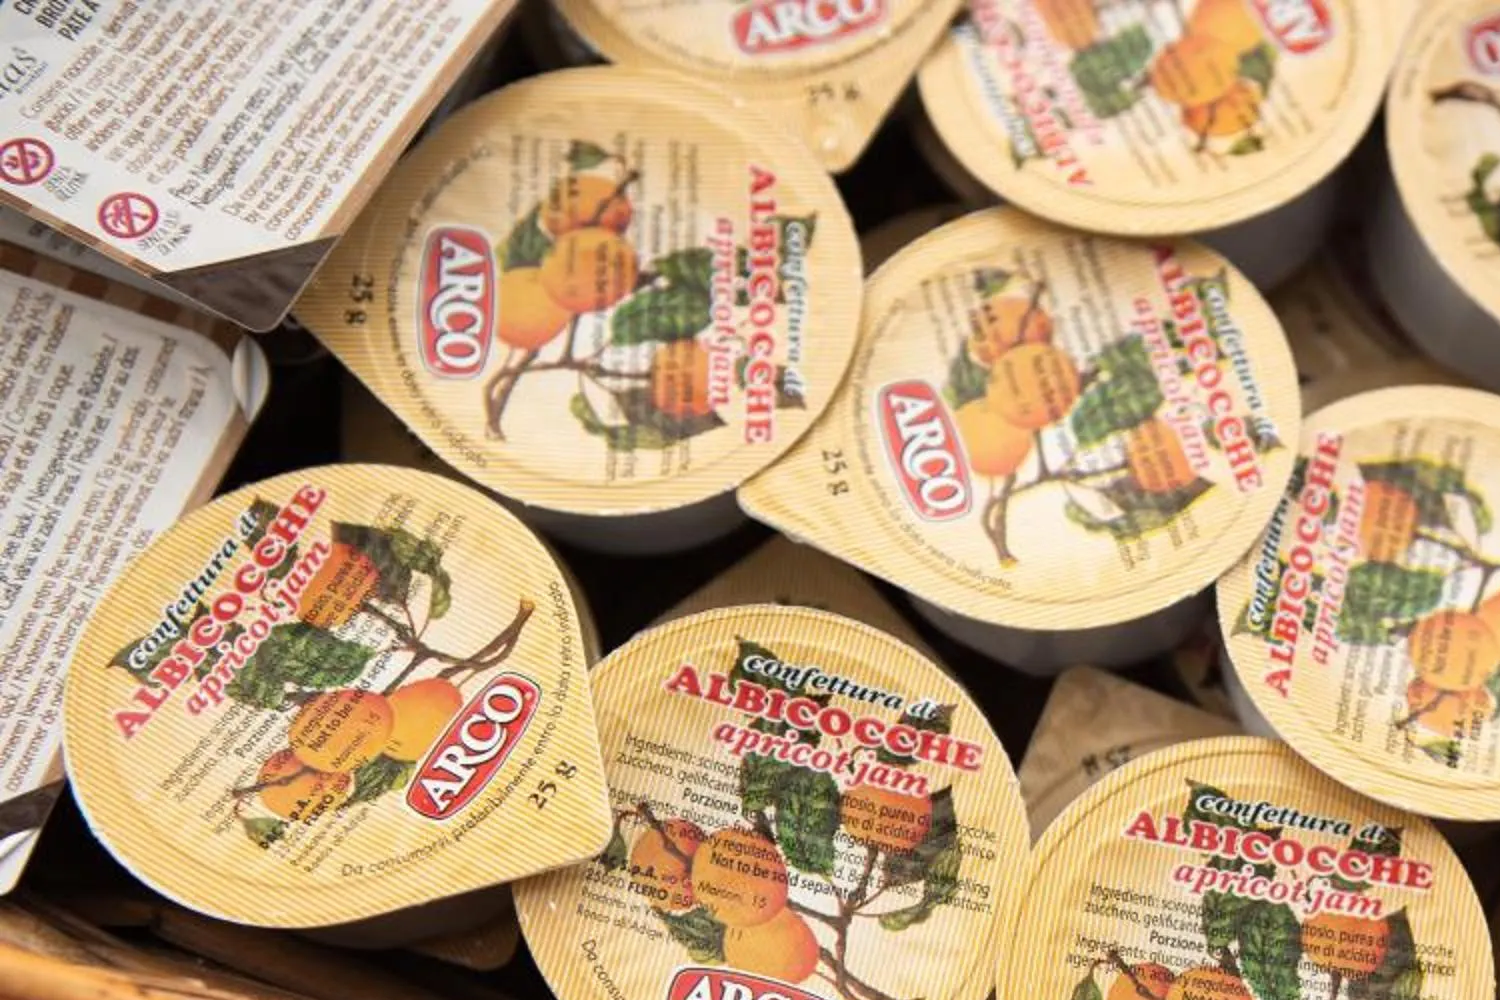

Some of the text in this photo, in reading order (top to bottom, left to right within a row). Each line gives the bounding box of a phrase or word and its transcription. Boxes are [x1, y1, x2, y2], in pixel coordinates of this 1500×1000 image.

[351, 273, 374, 301] 25
[430, 237, 485, 372] ARCO
[745, 167, 777, 444] ALBICOCCHE
[783, 222, 809, 362] confettura
[1132, 297, 1210, 470] apricot jam
[1149, 243, 1263, 492] ALBICOCCHE
[1205, 286, 1261, 413] confettura
[821, 448, 844, 476] 25
[890, 393, 966, 511] ARCO
[111, 484, 327, 740] ALBICOCCHE
[127, 507, 261, 667] confettura di
[1263, 433, 1343, 697] ALBICOCCHE
[1315, 479, 1366, 664] apricot jam
[186, 536, 332, 717] apricot jam
[743, 654, 940, 719] confettura di
[421, 685, 525, 810] ARCO
[667, 663, 982, 771] ALBICOCCHE
[713, 722, 928, 795] apricot jam
[529, 760, 579, 808] 25 g
[1196, 794, 1386, 842] confettura di
[1122, 812, 1434, 891] ALBICOCCHE
[1172, 860, 1382, 919] apricot jam
[582, 939, 596, 958] Da
[1149, 931, 1204, 953] Porzione
